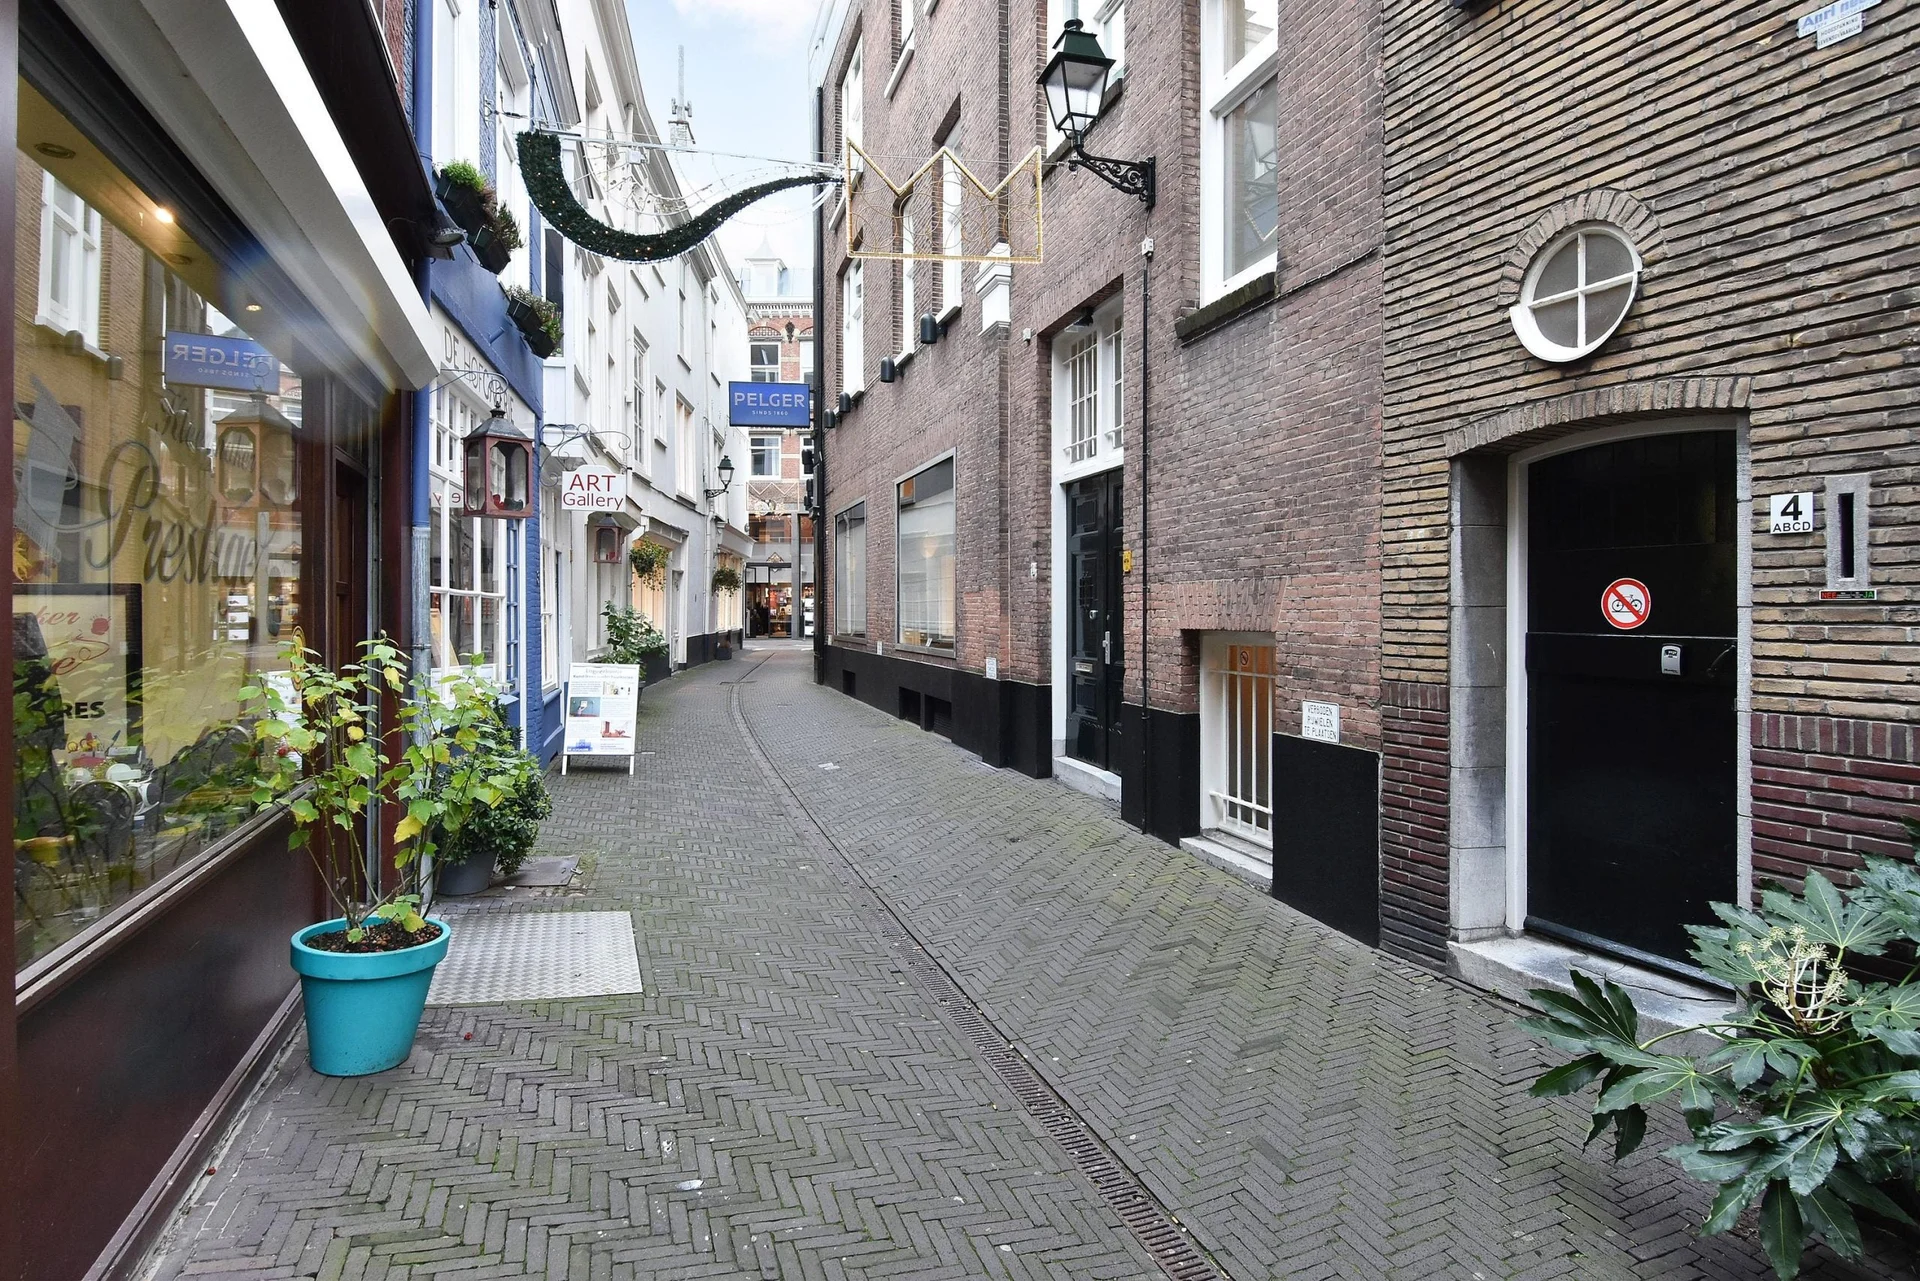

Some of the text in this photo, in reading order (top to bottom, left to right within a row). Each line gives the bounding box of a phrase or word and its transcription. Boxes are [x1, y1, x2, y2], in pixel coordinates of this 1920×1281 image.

[444, 326, 460, 373] DE
[734, 392, 805, 408] PELGER
[569, 473, 616, 492] ART
[563, 492, 623, 511] Gallery
[1780, 494, 1803, 521] 4
[1772, 521, 1811, 533] ABCD
[1821, 591, 1836, 599] NEE
[1307, 704, 1333, 716] VERBODEN
[1304, 725, 1337, 740] TE PLAATSEN
